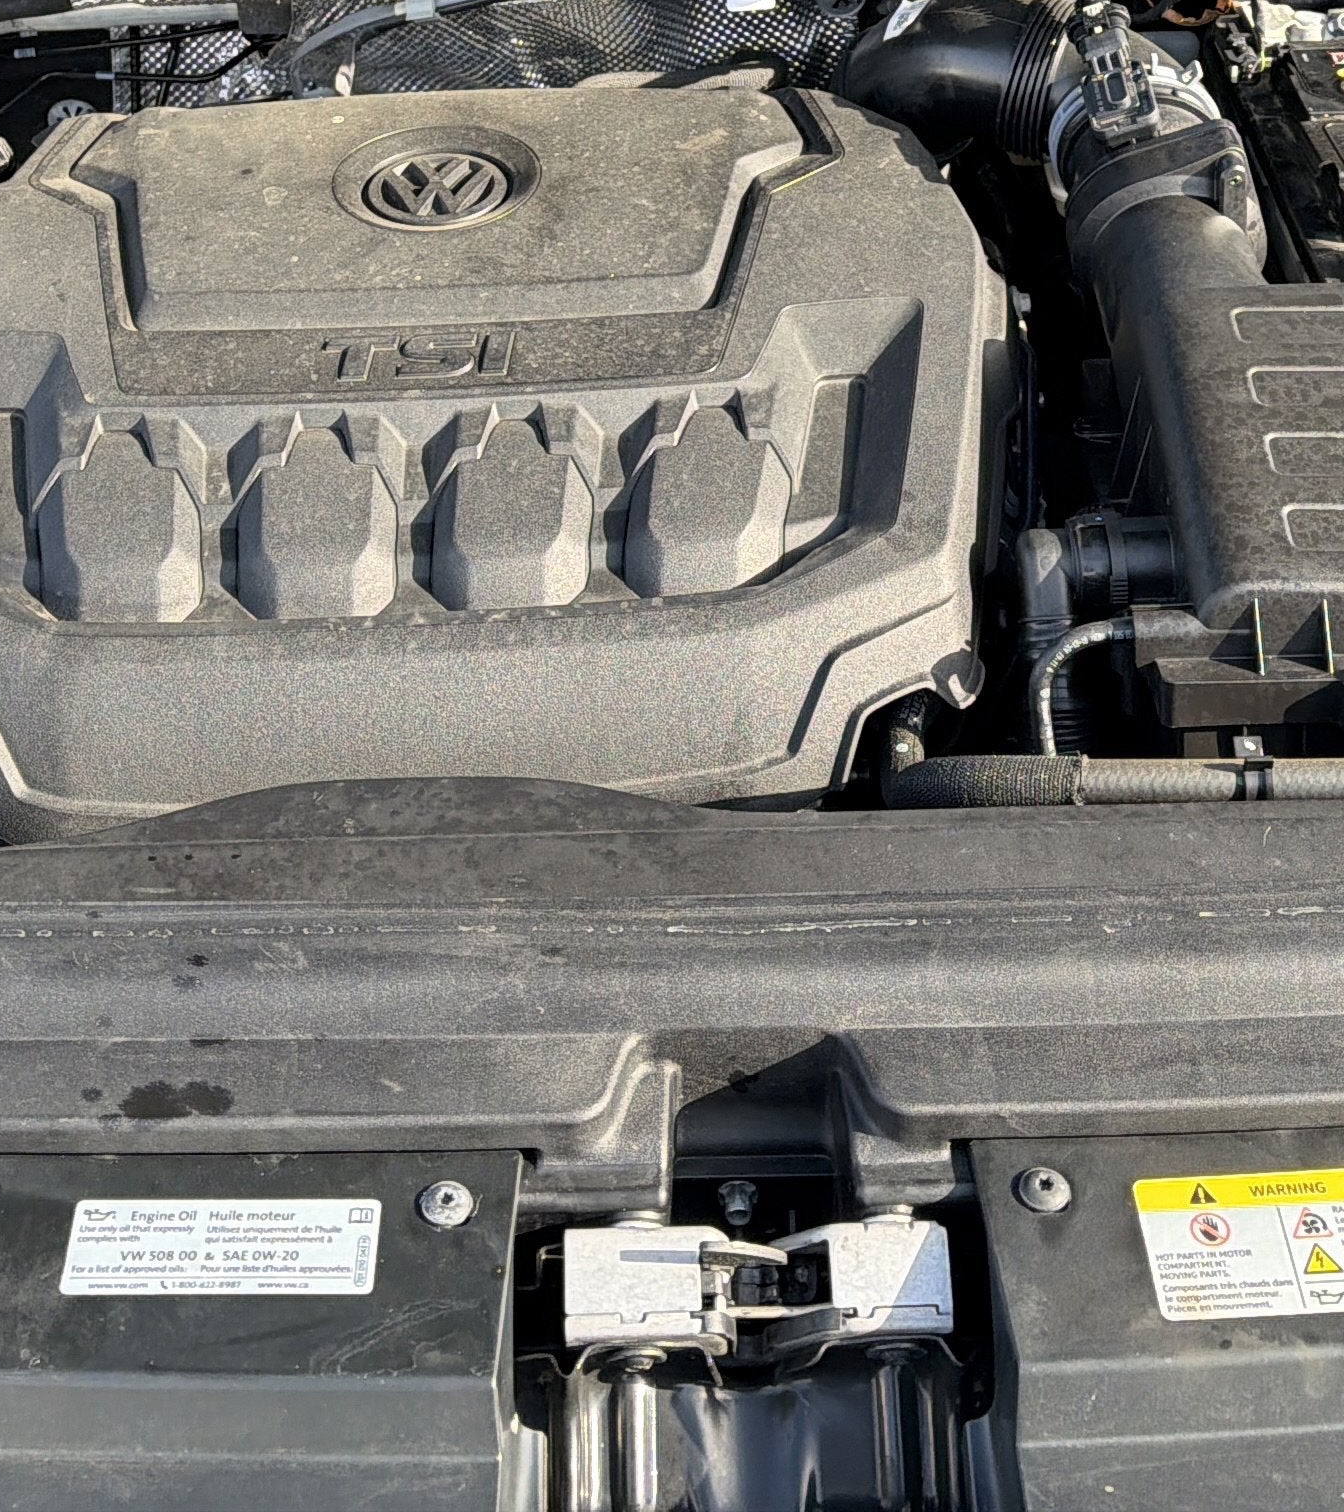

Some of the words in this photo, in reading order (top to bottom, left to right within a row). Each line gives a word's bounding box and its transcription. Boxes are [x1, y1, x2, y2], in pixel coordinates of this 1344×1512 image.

[321, 330, 516, 383] TSI
[1248, 1181, 1327, 1198] WARNING
[130, 1210, 176, 1224] Engine
[178, 1210, 198, 1221] Oil
[208, 1210, 244, 1222] Huile
[246, 1211, 297, 1221] moteur
[79, 1225, 97, 1233] Use
[97, 1225, 118, 1235] only
[118, 1225, 130, 1233] oil
[132, 1225, 152, 1233] that
[152, 1225, 196, 1235] expressly
[206, 1225, 241, 1234] Utilisez
[242, 1225, 299, 1235] uniquement
[300, 1225, 314, 1234] de
[314, 1225, 343, 1234] l'huile
[76, 1235, 118, 1244] complies
[118, 1234, 141, 1243] with
[204, 1235, 221, 1245] qui
[221, 1235, 259, 1244] satisfait
[326, 1234, 334, 1244] à
[120, 1250, 146, 1262] VW
[148, 1250, 175, 1262] 508
[178, 1250, 198, 1262] 00
[204, 1251, 216, 1261] &
[222, 1250, 249, 1261] SAE
[251, 1249, 300, 1262] 0W-20
[1155, 1253, 1175, 1262] HOT
[1176, 1251, 1205, 1260] PARTS
[1206, 1251, 1218, 1259] IN
[1218, 1249, 1253, 1259] MOTOR
[70, 1264, 86, 1274] For
[95, 1264, 111, 1273] list
[111, 1264, 123, 1274] of
[122, 1264, 168, 1275] approved
[200, 1264, 222, 1274] Pour
[222, 1265, 241, 1273] une
[241, 1264, 261, 1273] liste
[1159, 1271, 1198, 1281] MOVING
[1162, 1281, 1219, 1294] Composants
[1239, 1279, 1272, 1289] chauds
[1272, 1278, 1294, 1287] dans
[1164, 1294, 1174, 1303] le
[1175, 1290, 1244, 1305] compartiment
[1167, 1303, 1198, 1313] Pièces
[1199, 1304, 1212, 1314] en
